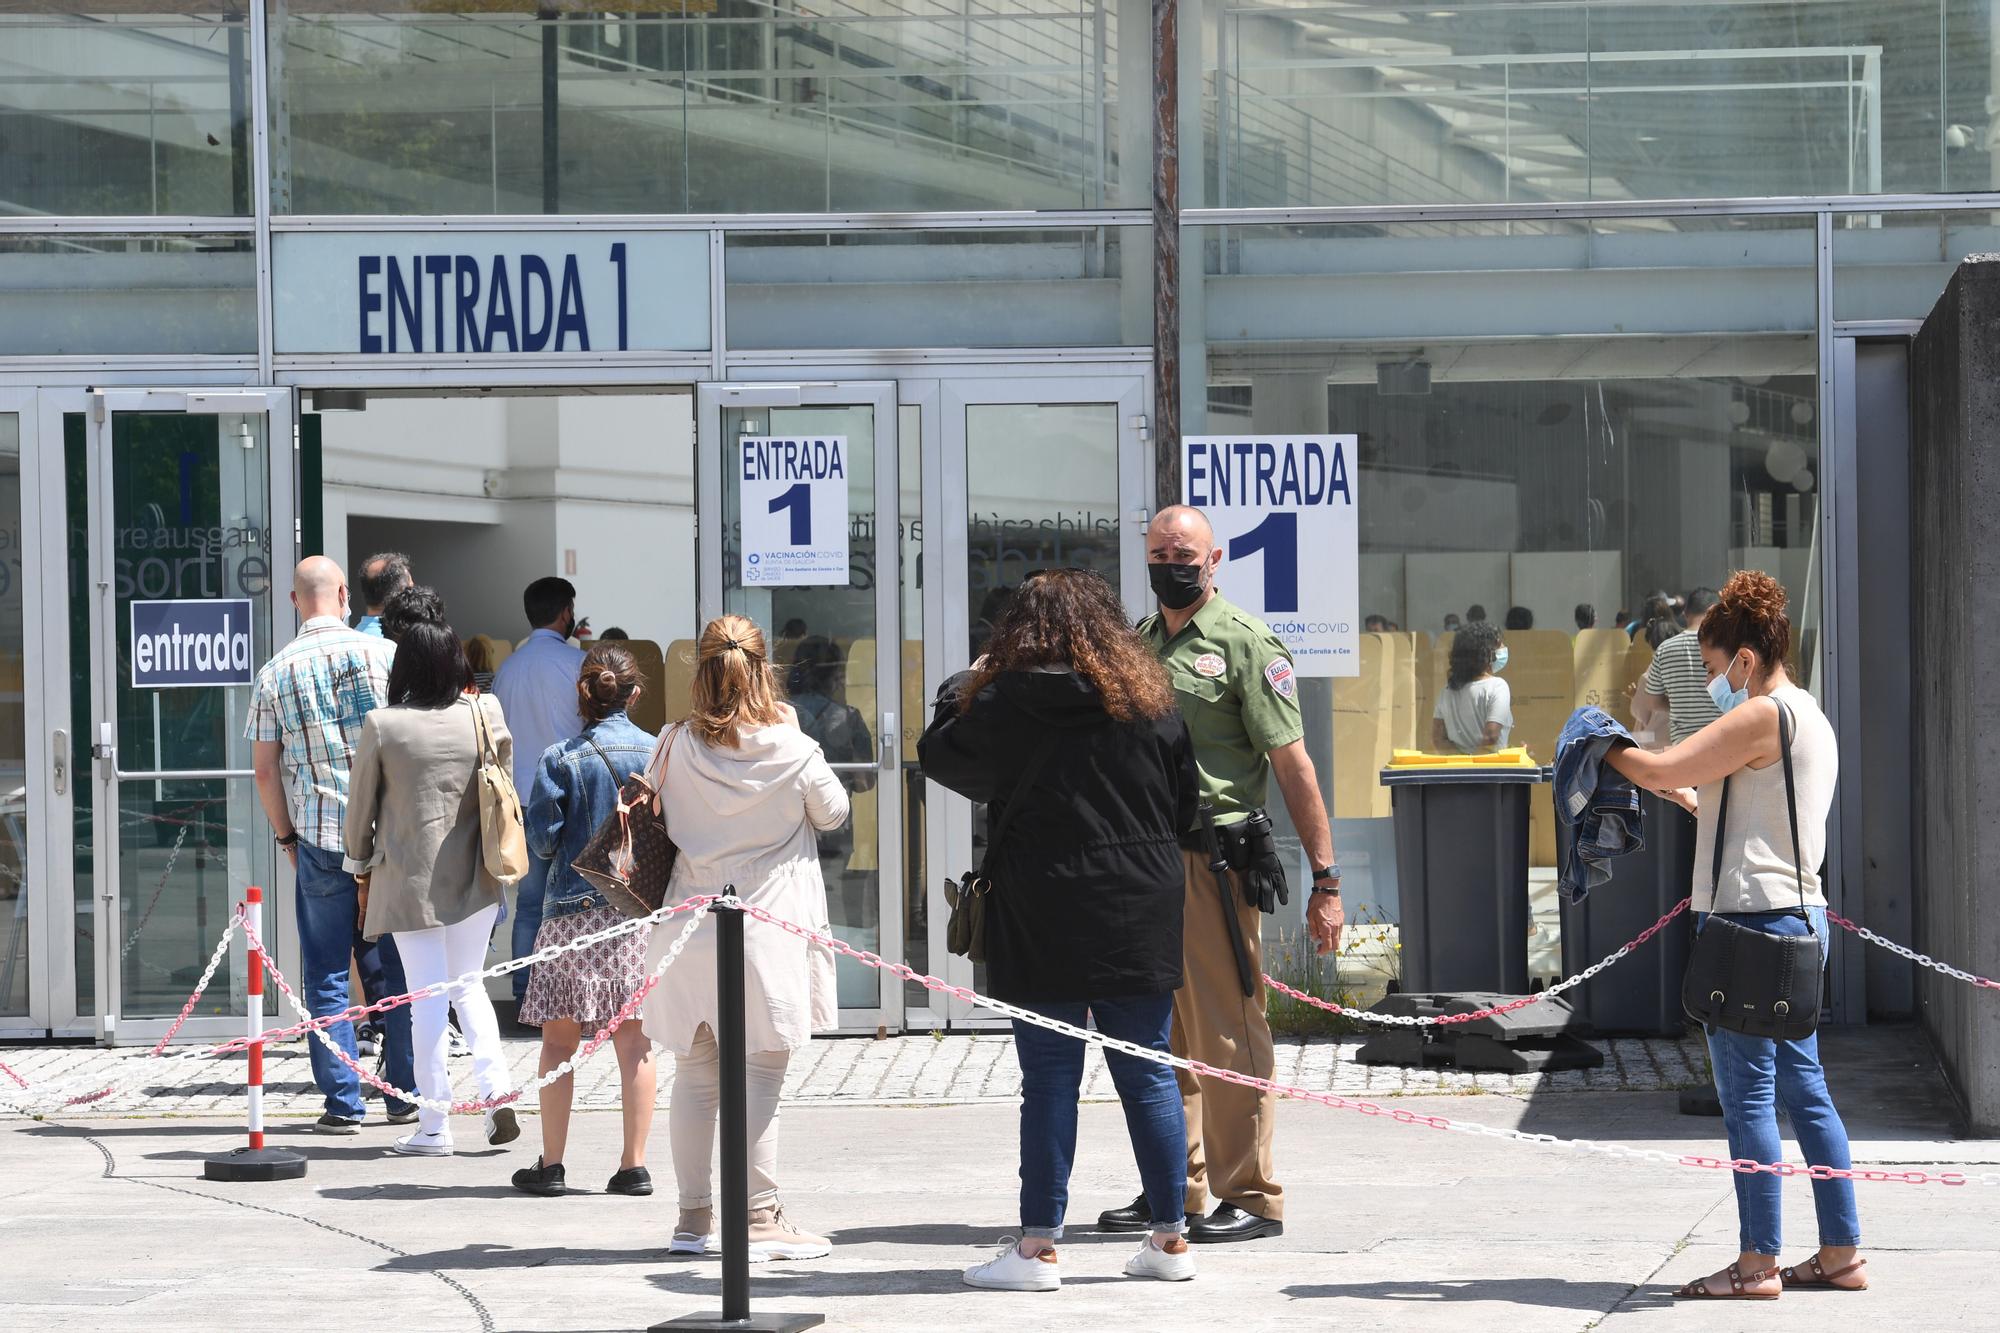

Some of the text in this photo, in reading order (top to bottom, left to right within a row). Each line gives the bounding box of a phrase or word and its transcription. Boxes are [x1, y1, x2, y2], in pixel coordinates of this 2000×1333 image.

[358, 242, 628, 353] ENTRADA 1
[743, 440, 844, 480] ENTRADA
[1188, 442, 1352, 507] ENTRADA
[768, 483, 812, 546] 1
[115, 546, 270, 599] sortie
[764, 550, 843, 559] VACINACIÓN COVID
[1228, 511, 1299, 613] 1
[136, 613, 249, 673] entrada
[1307, 622, 1350, 634] COVID
[1271, 663, 1288, 676] EULEN
